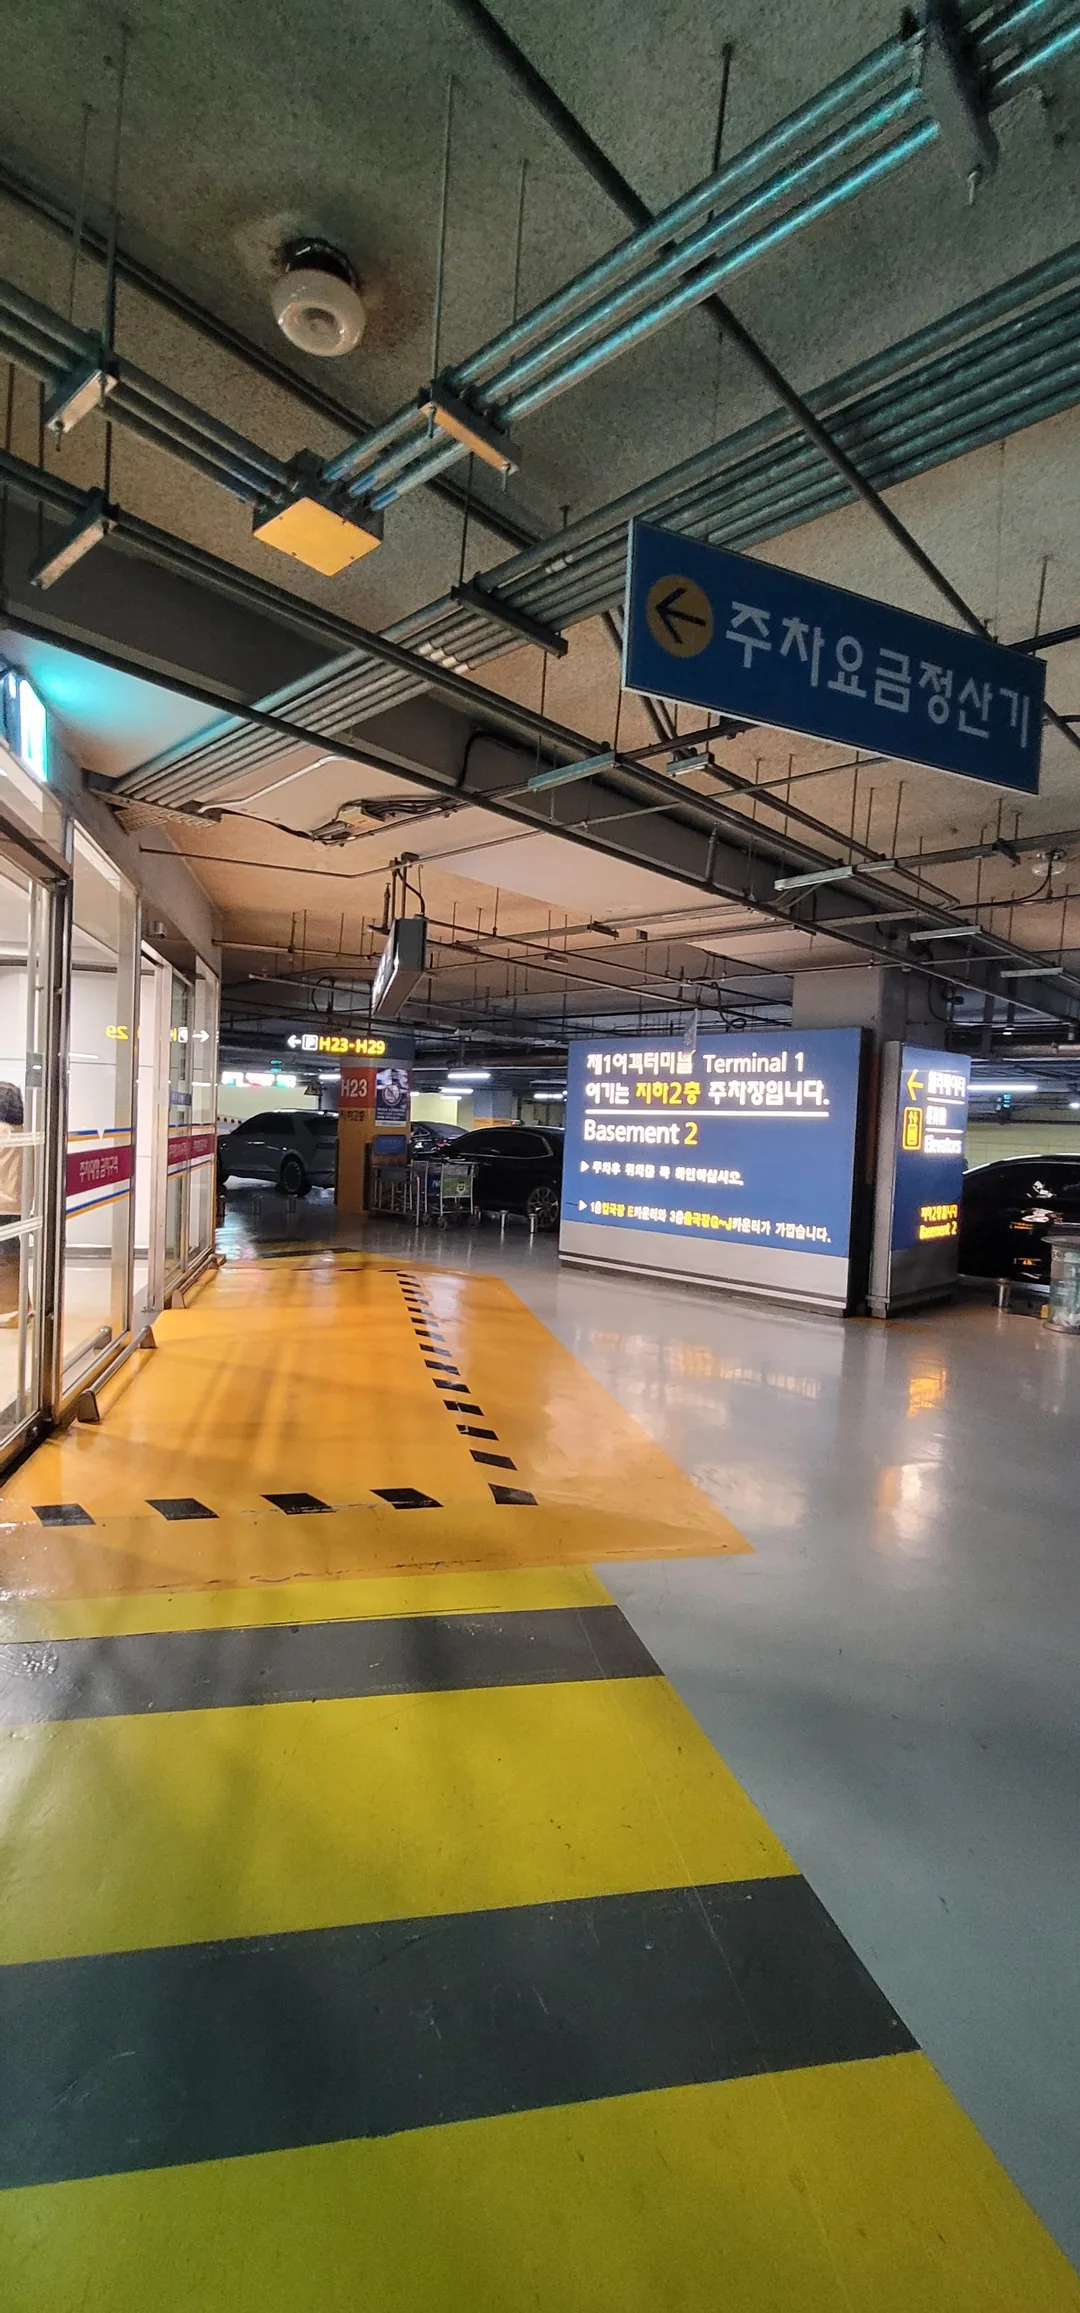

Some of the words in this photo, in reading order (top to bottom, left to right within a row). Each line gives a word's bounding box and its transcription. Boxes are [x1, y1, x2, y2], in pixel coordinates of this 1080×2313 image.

[725, 600, 1030, 749] 주차요금정산기
[319, 1036, 386, 1055] H23-H29
[702, 1051, 787, 1074] Terminal
[794, 1052, 804, 1073] 1
[340, 1078, 368, 1098] H23
[585, 1082, 630, 1105] 여기는
[635, 1081, 702, 1105] 지하2층
[707, 1080, 830, 1106] 주차장입니다.
[583, 1119, 681, 1144] Basement
[683, 1122, 698, 1145] 2
